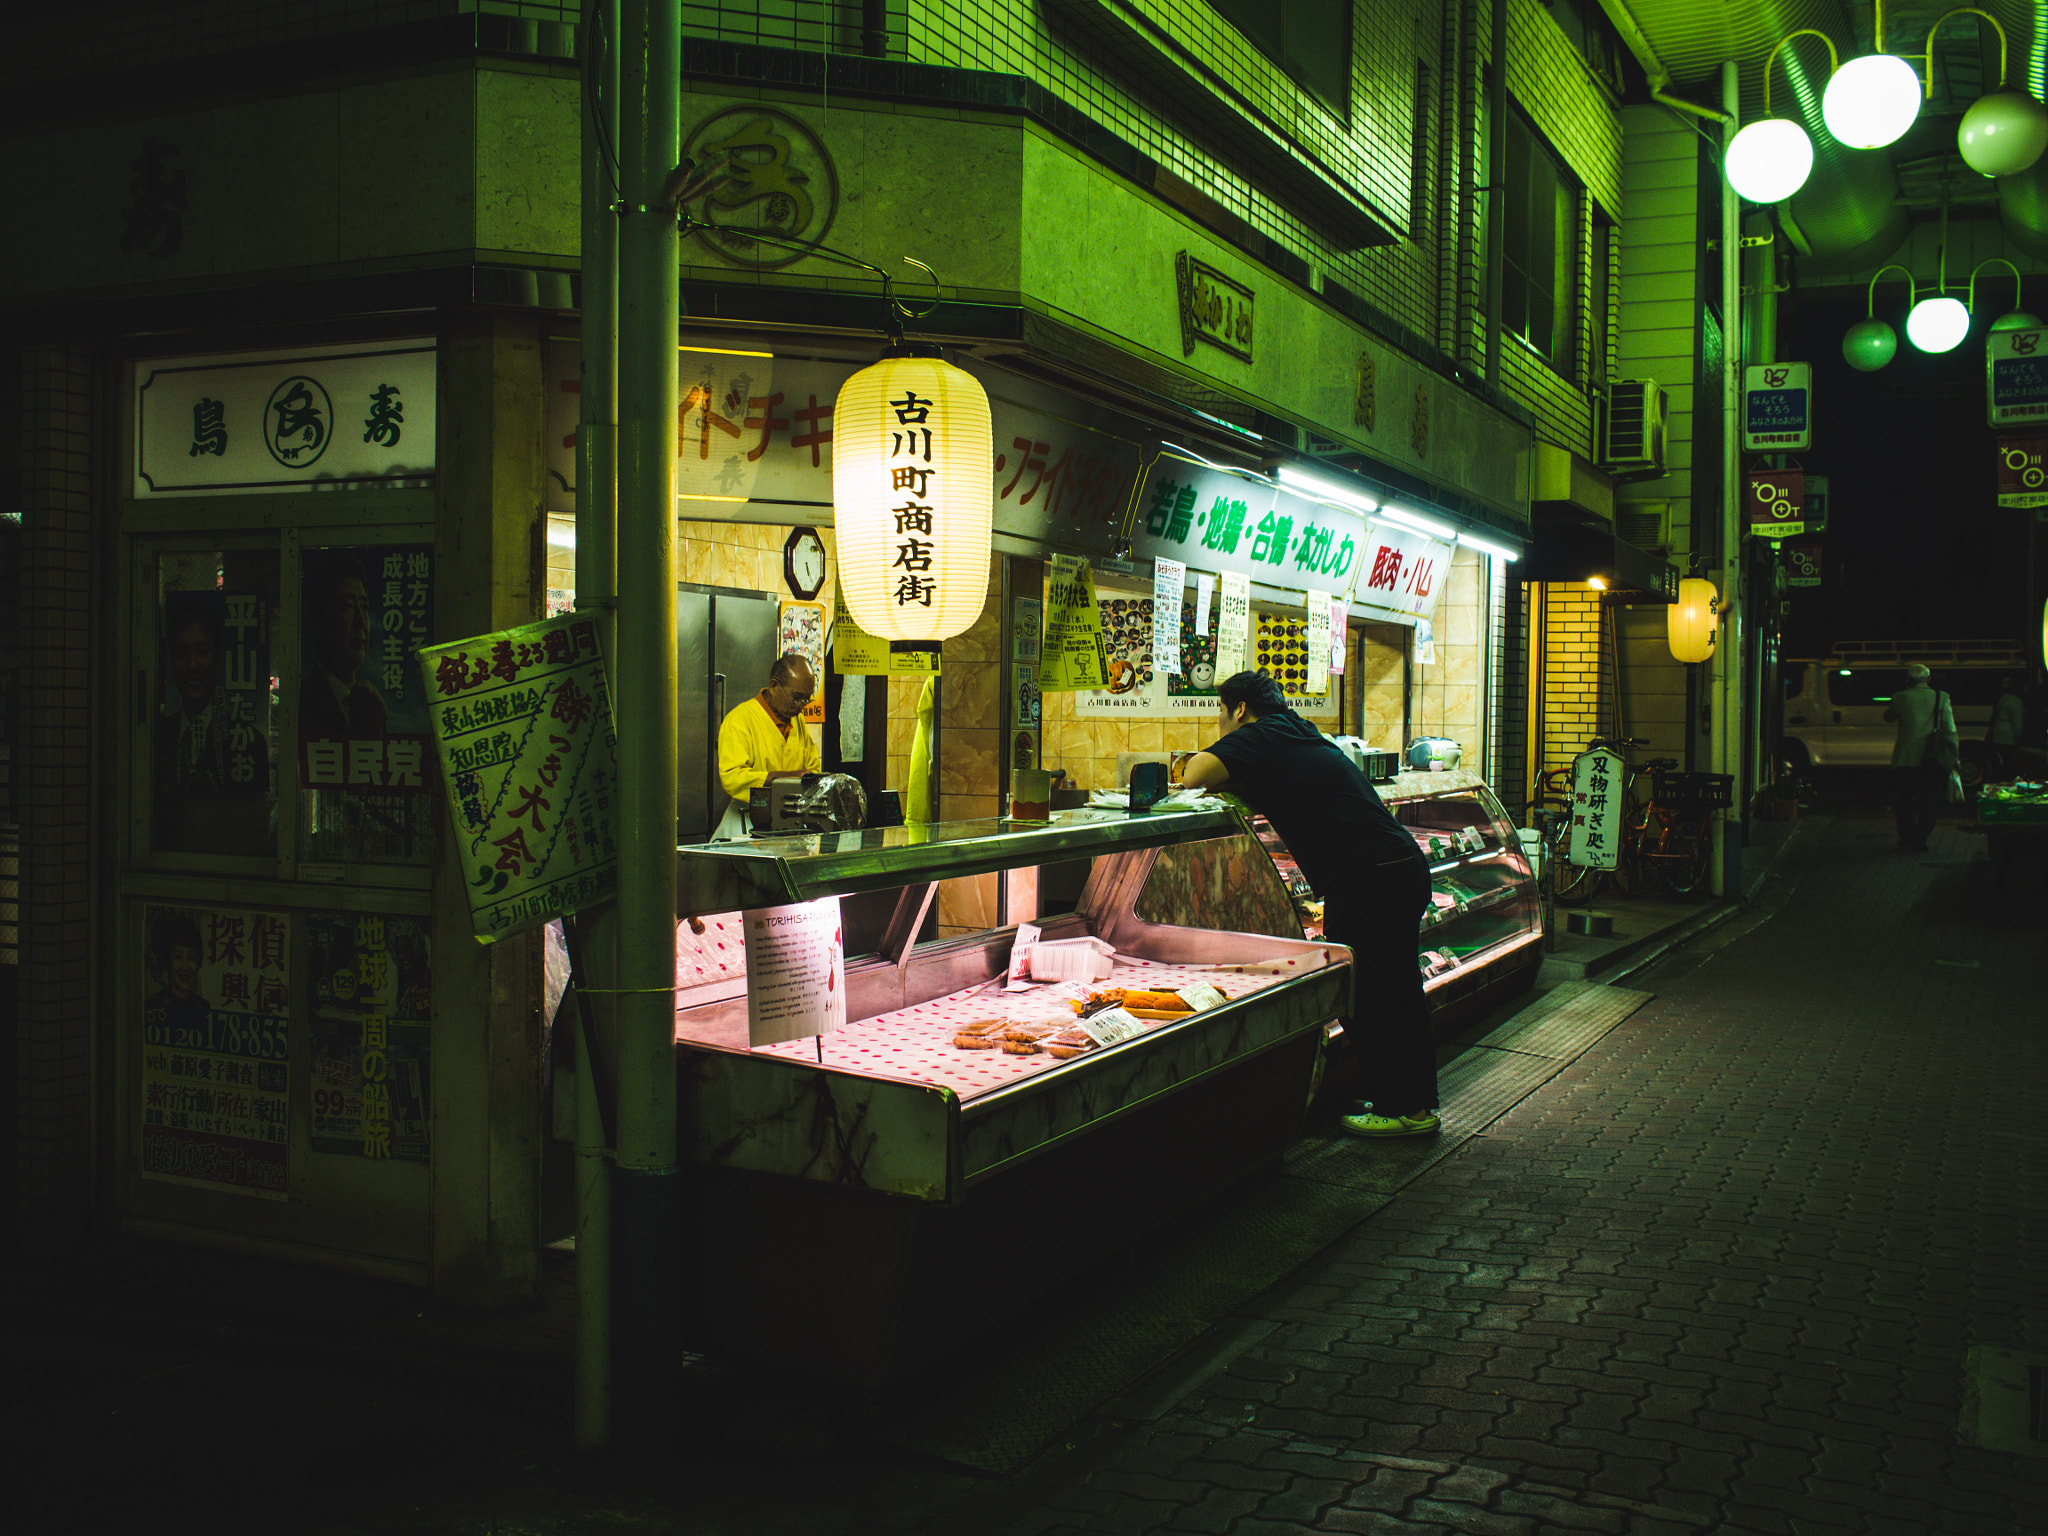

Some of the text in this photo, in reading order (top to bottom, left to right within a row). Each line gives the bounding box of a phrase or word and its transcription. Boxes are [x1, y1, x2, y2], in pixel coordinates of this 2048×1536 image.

[188, 383, 405, 457] 鳥 寿
[889, 390, 937, 608] 古川町商店街
[1368, 545, 1434, 598] 豚肉・ハム
[306, 738, 423, 787] 自民党
[207, 913, 287, 972] 探偵
